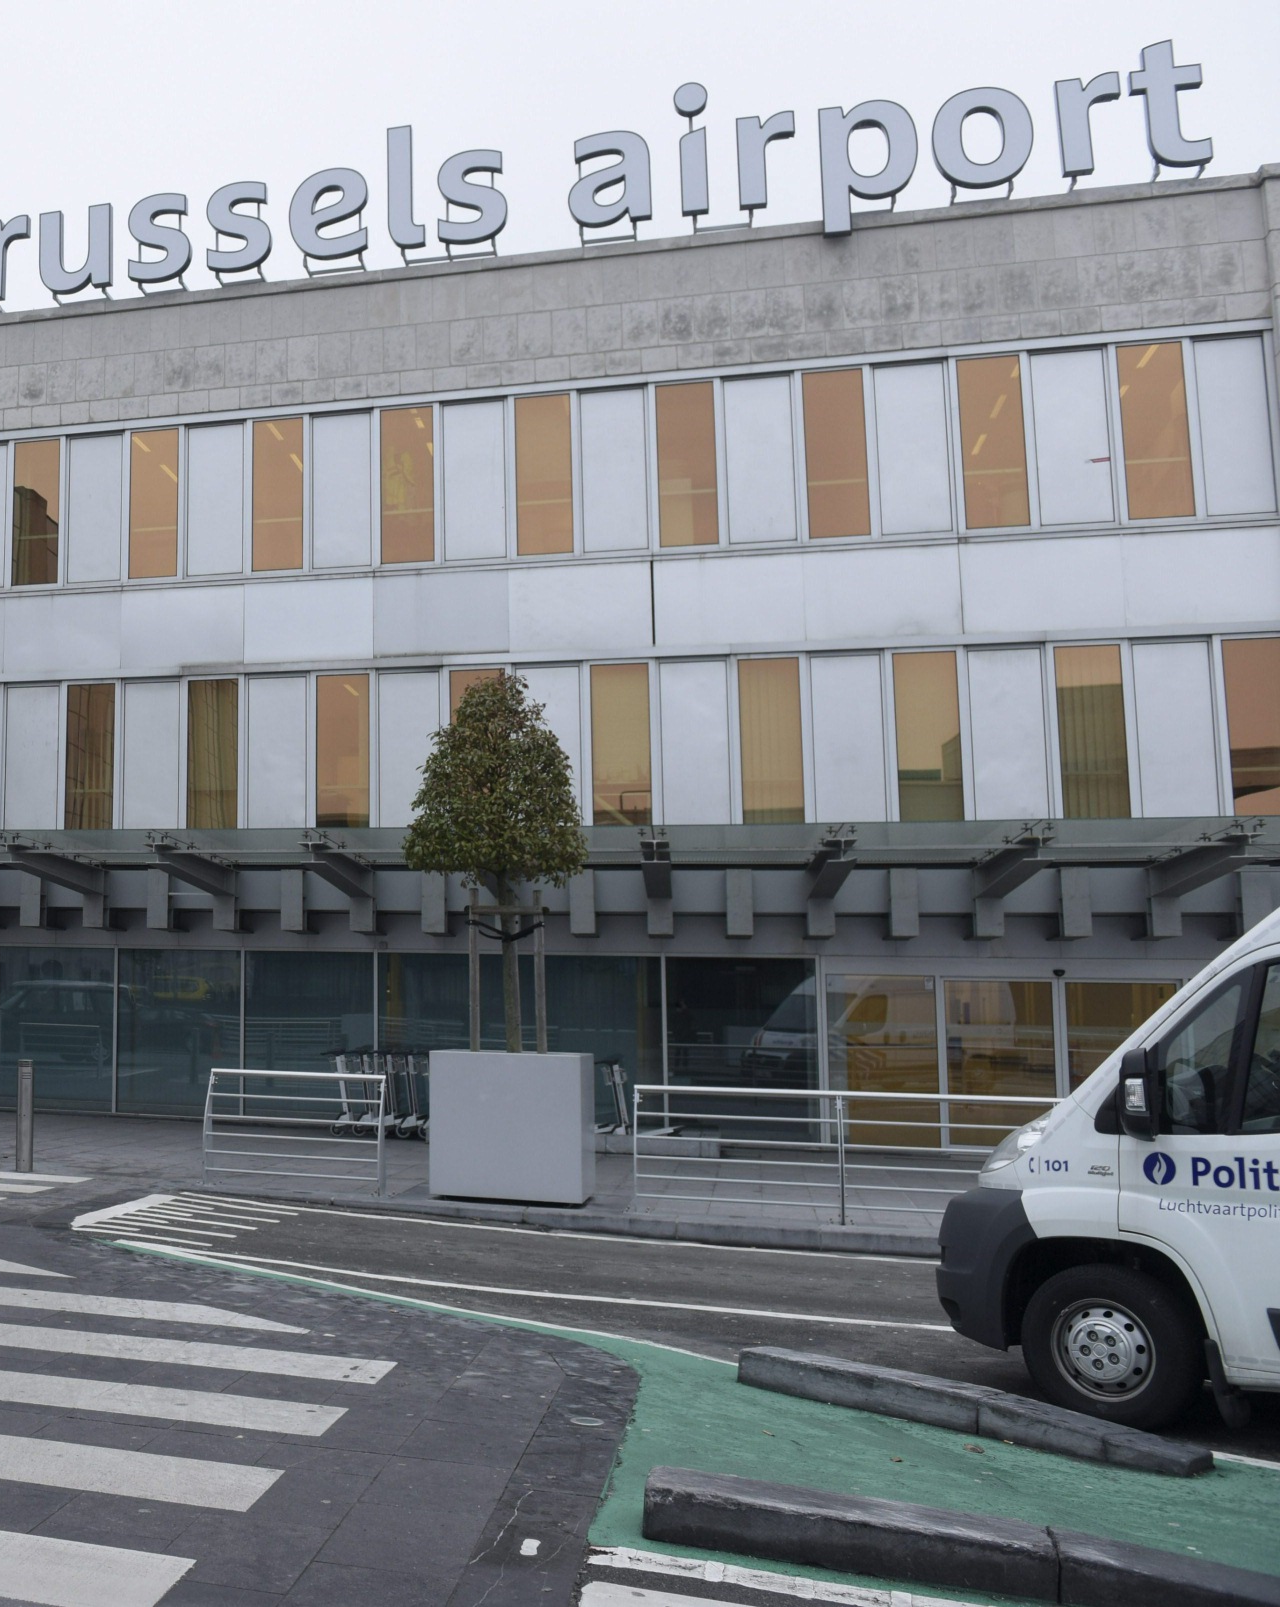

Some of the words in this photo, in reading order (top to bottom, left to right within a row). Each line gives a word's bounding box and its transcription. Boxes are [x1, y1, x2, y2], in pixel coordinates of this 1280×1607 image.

[568, 39, 1213, 238] airport
[1044, 1159, 1069, 1172] 101
[1191, 1157, 1280, 1192] Polit
[1158, 1198, 1280, 1222] Luchtvaartpoli
